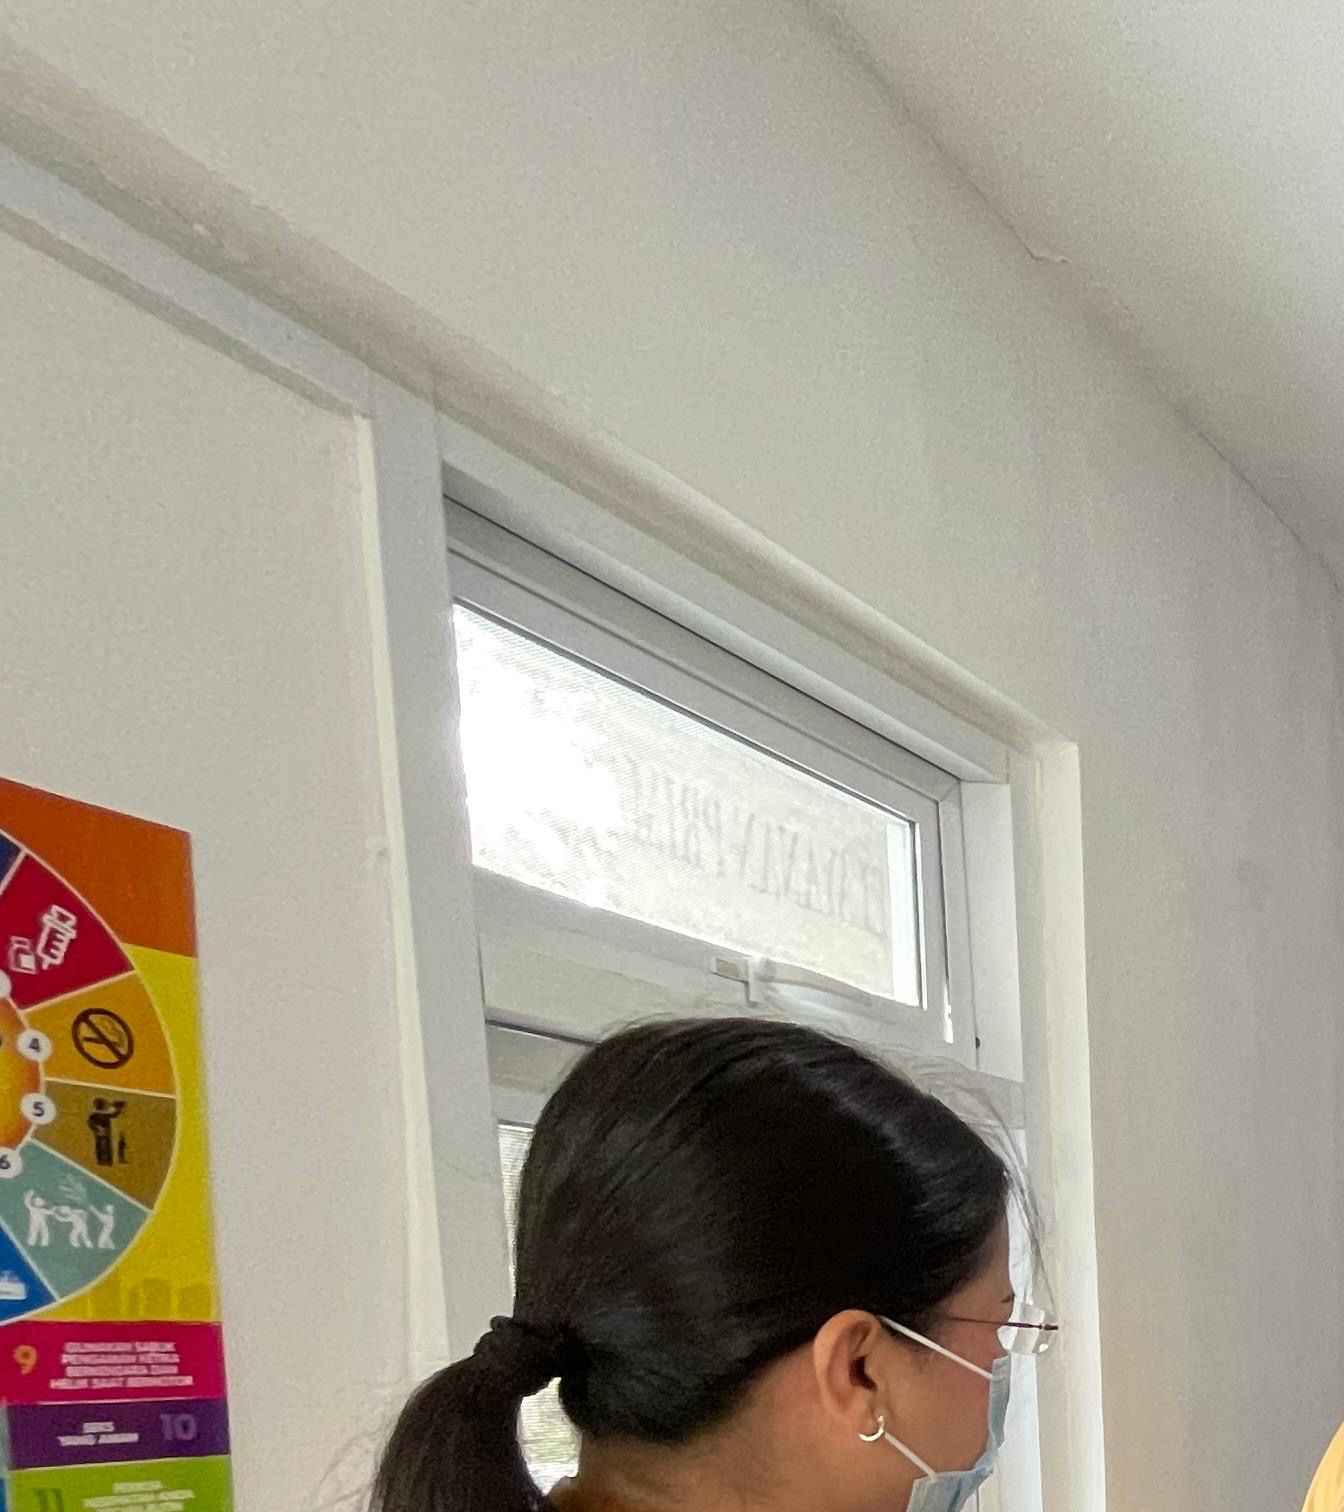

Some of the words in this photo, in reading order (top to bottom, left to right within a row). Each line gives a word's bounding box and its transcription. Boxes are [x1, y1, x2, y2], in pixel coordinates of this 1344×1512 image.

[28, 1038, 41, 1053] 4
[32, 1102, 46, 1117] 5
[0, 1155, 11, 1171] 6
[13, 1345, 38, 1375] 9
[160, 1413, 198, 1441] 10
